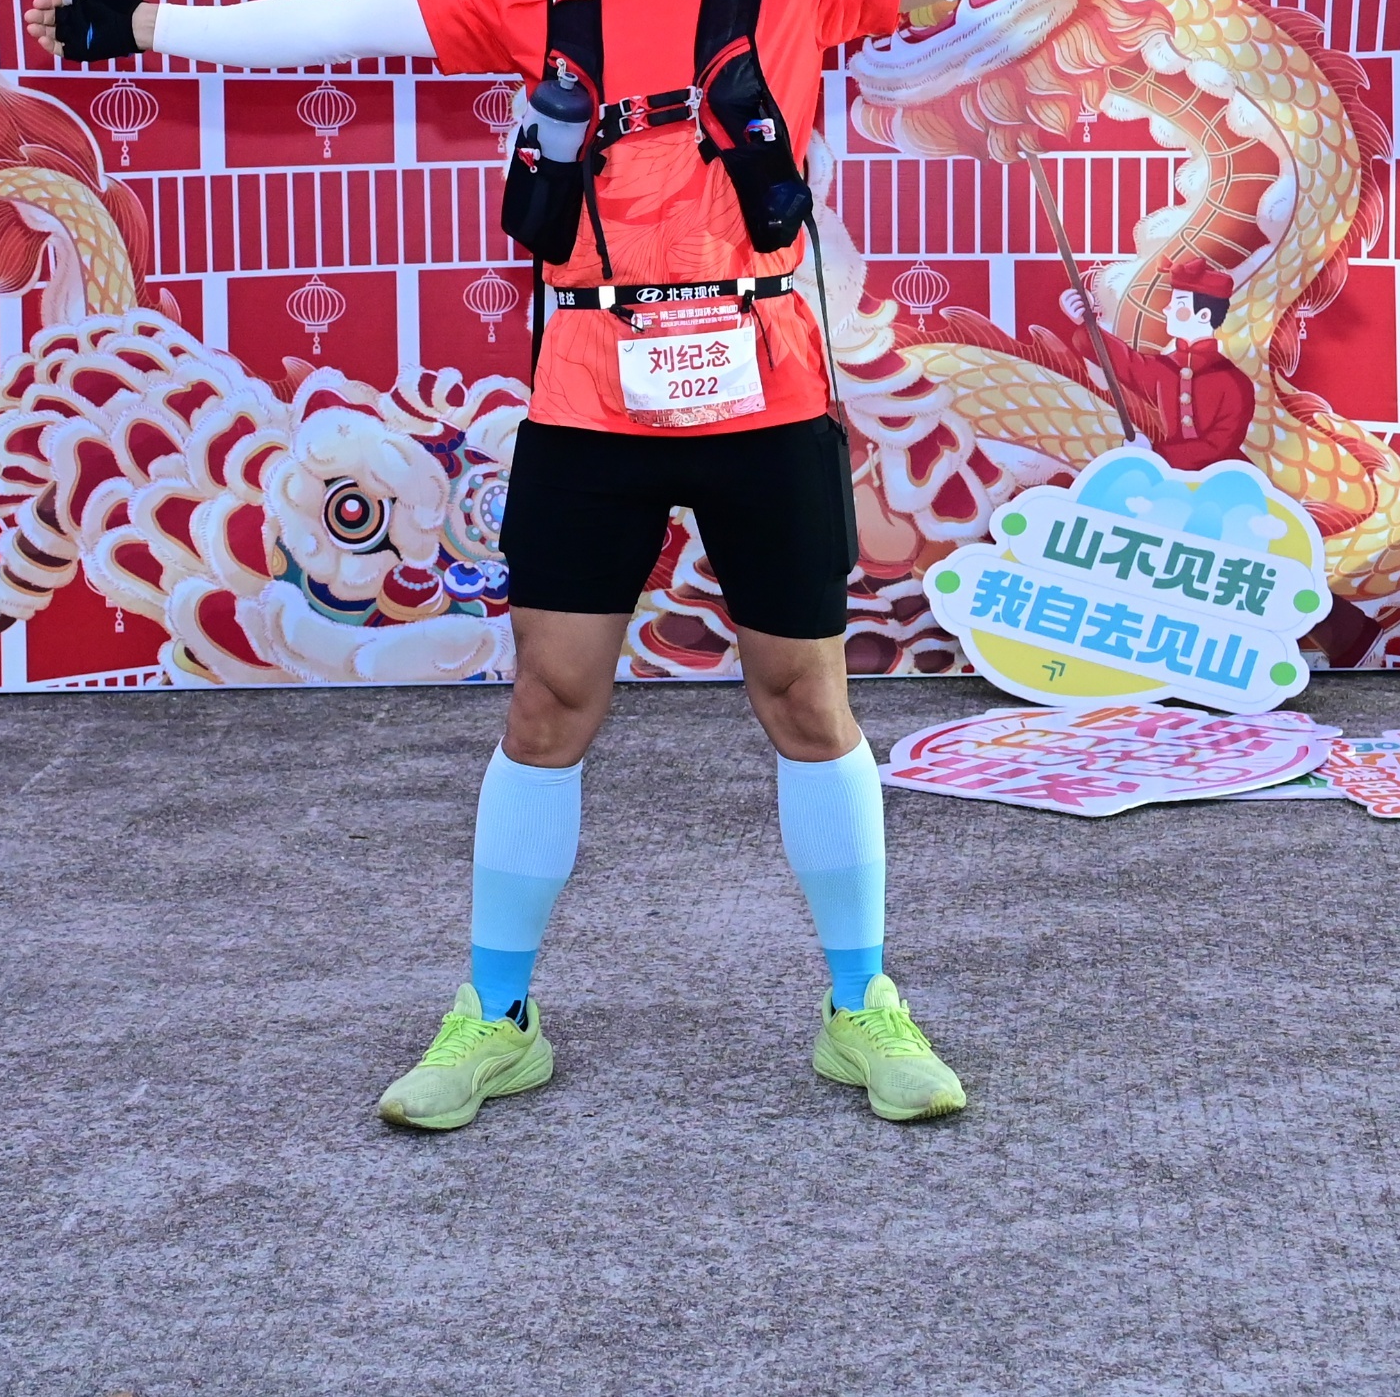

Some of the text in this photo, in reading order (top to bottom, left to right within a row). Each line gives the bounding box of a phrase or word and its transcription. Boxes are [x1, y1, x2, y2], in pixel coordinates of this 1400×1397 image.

[666, 285, 720, 302] 北京现代
[647, 340, 732, 374] 刘纪念
[667, 376, 719, 399] 2022
[1042, 515, 1278, 617] 山不见我
[970, 568, 1259, 692] 我自去见山
[1068, 705, 1274, 752] 快乐
[891, 756, 1142, 808] 出发
